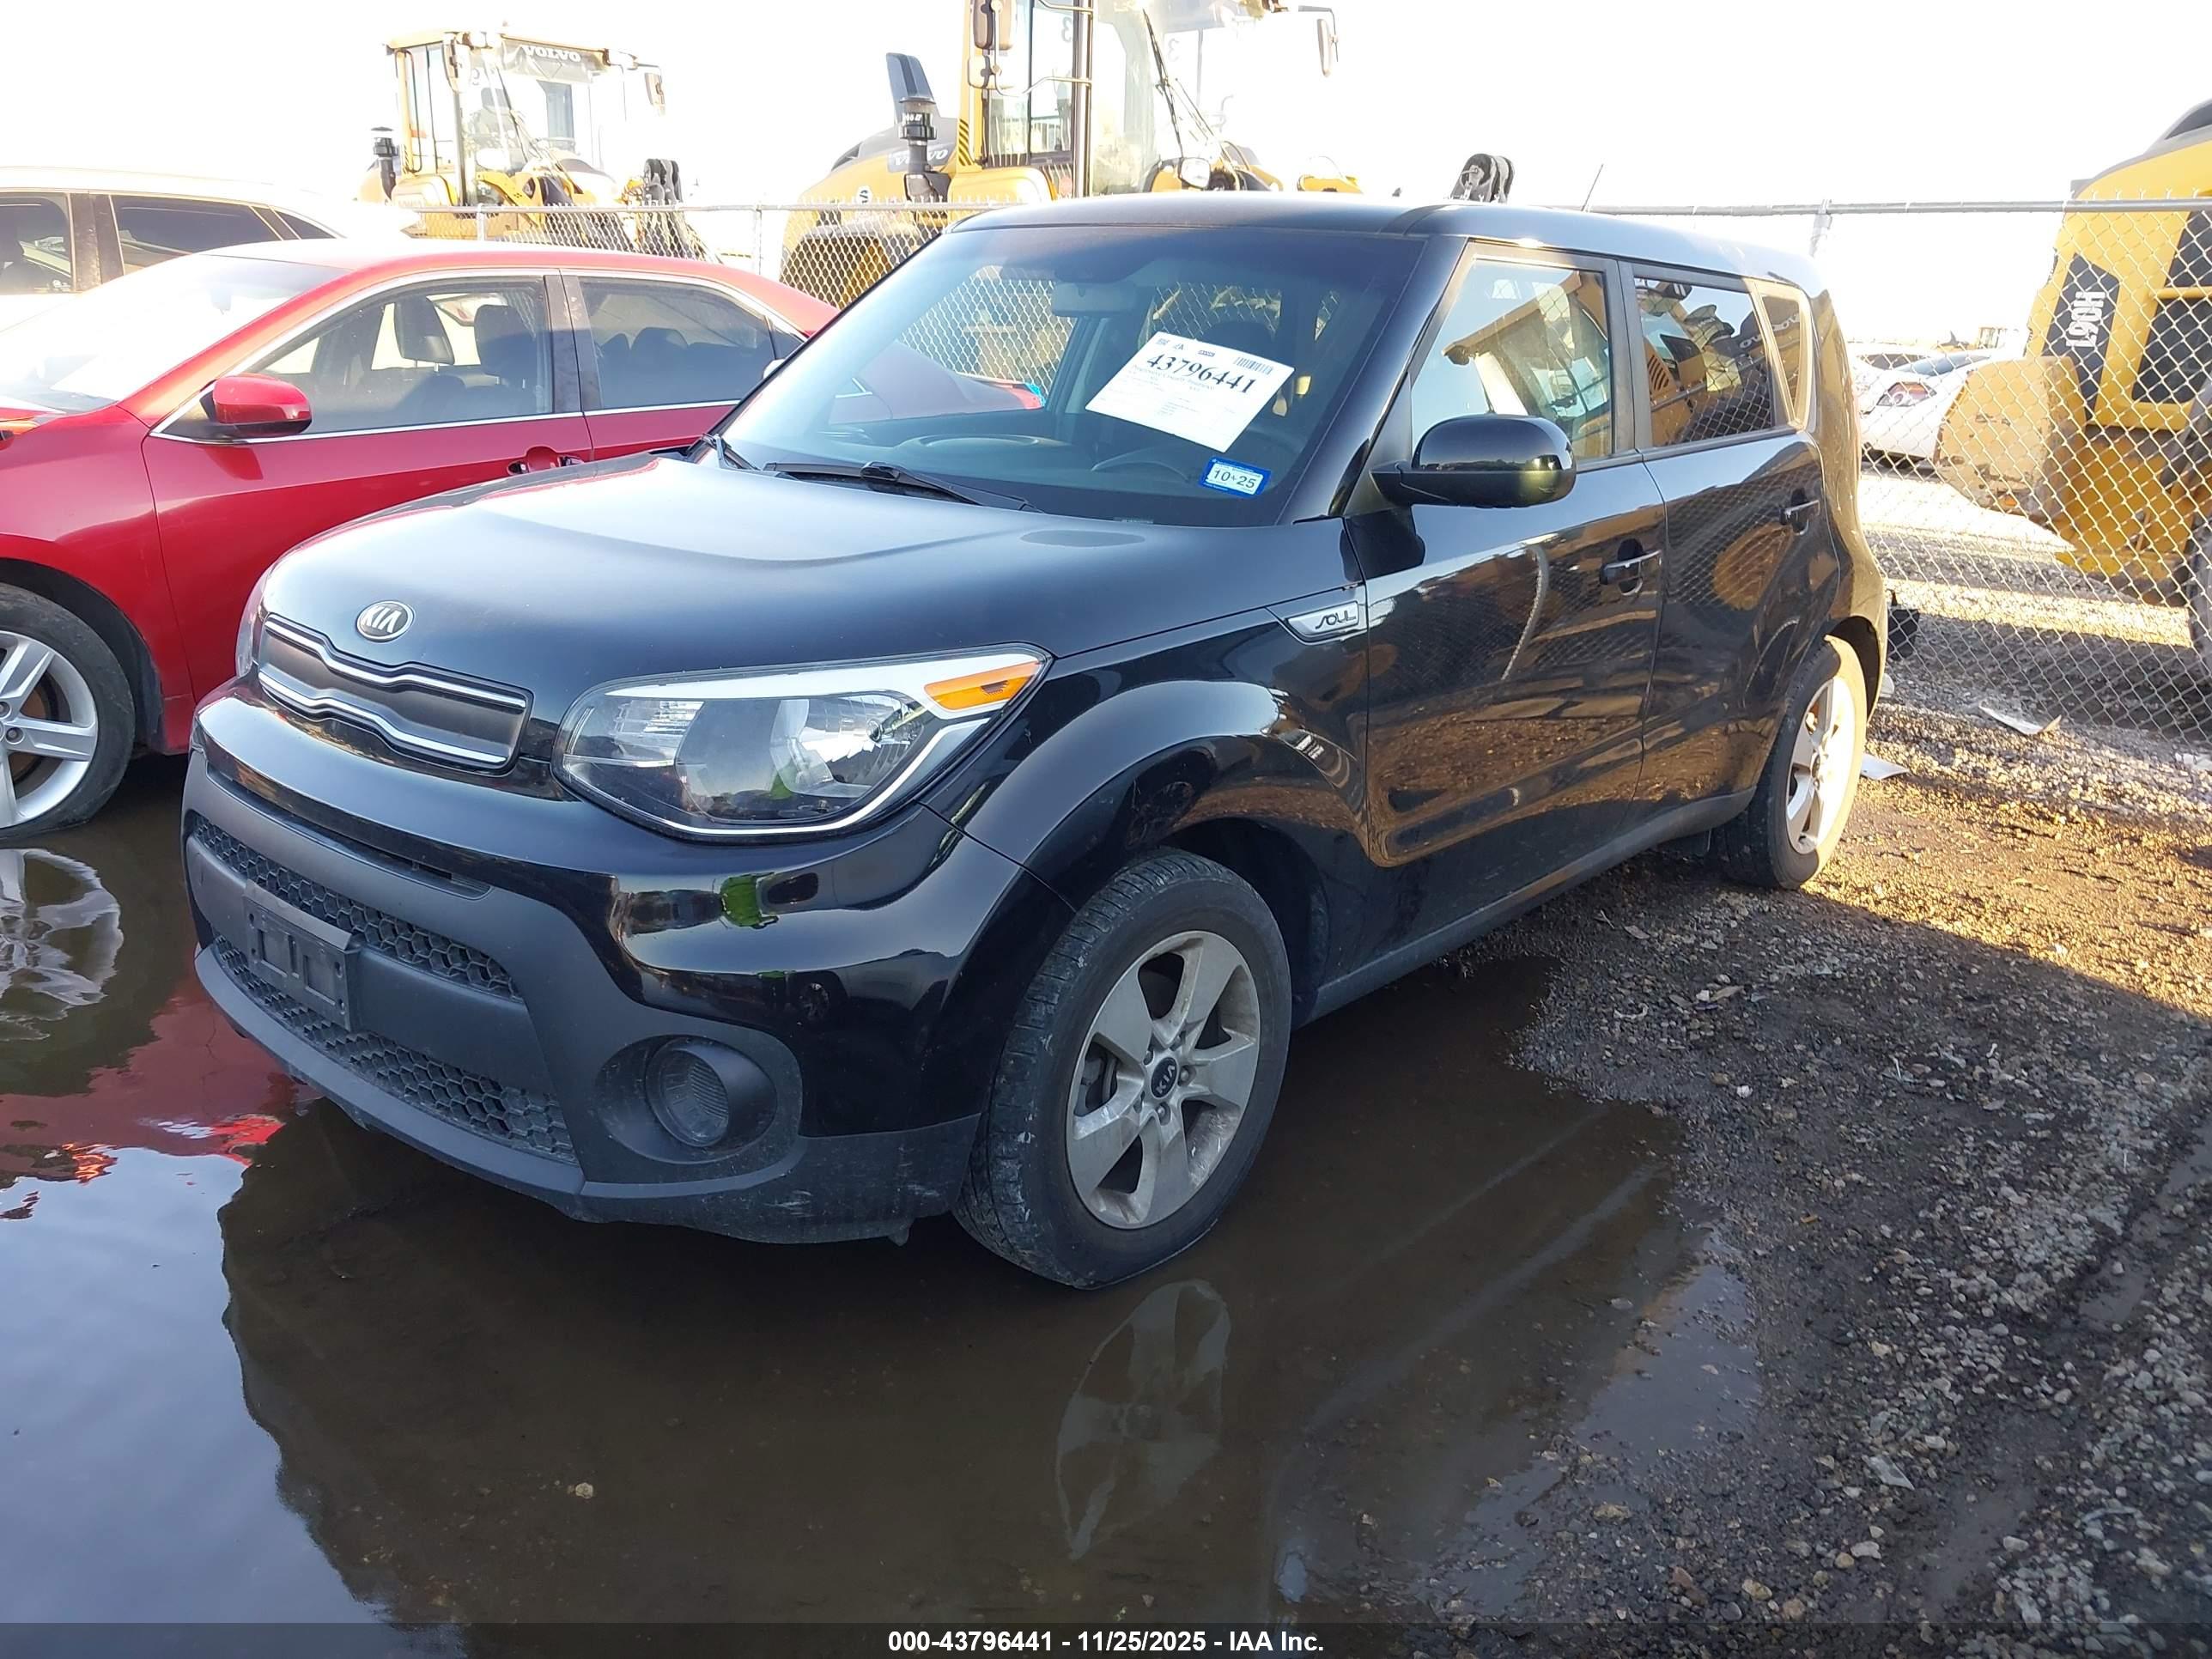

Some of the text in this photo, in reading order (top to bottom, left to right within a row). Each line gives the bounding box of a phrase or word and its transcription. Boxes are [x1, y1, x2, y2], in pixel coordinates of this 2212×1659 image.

[521, 45, 581, 62] VOLVO
[2065, 291, 2106, 347] L90H
[1146, 354, 1257, 392] 43796441
[1213, 470, 1231, 482] 10
[1236, 476, 1257, 489] 25
[362, 605, 402, 634] KIA
[1315, 610, 1357, 629] SOUL
[1155, 1065, 1176, 1095] KIA
